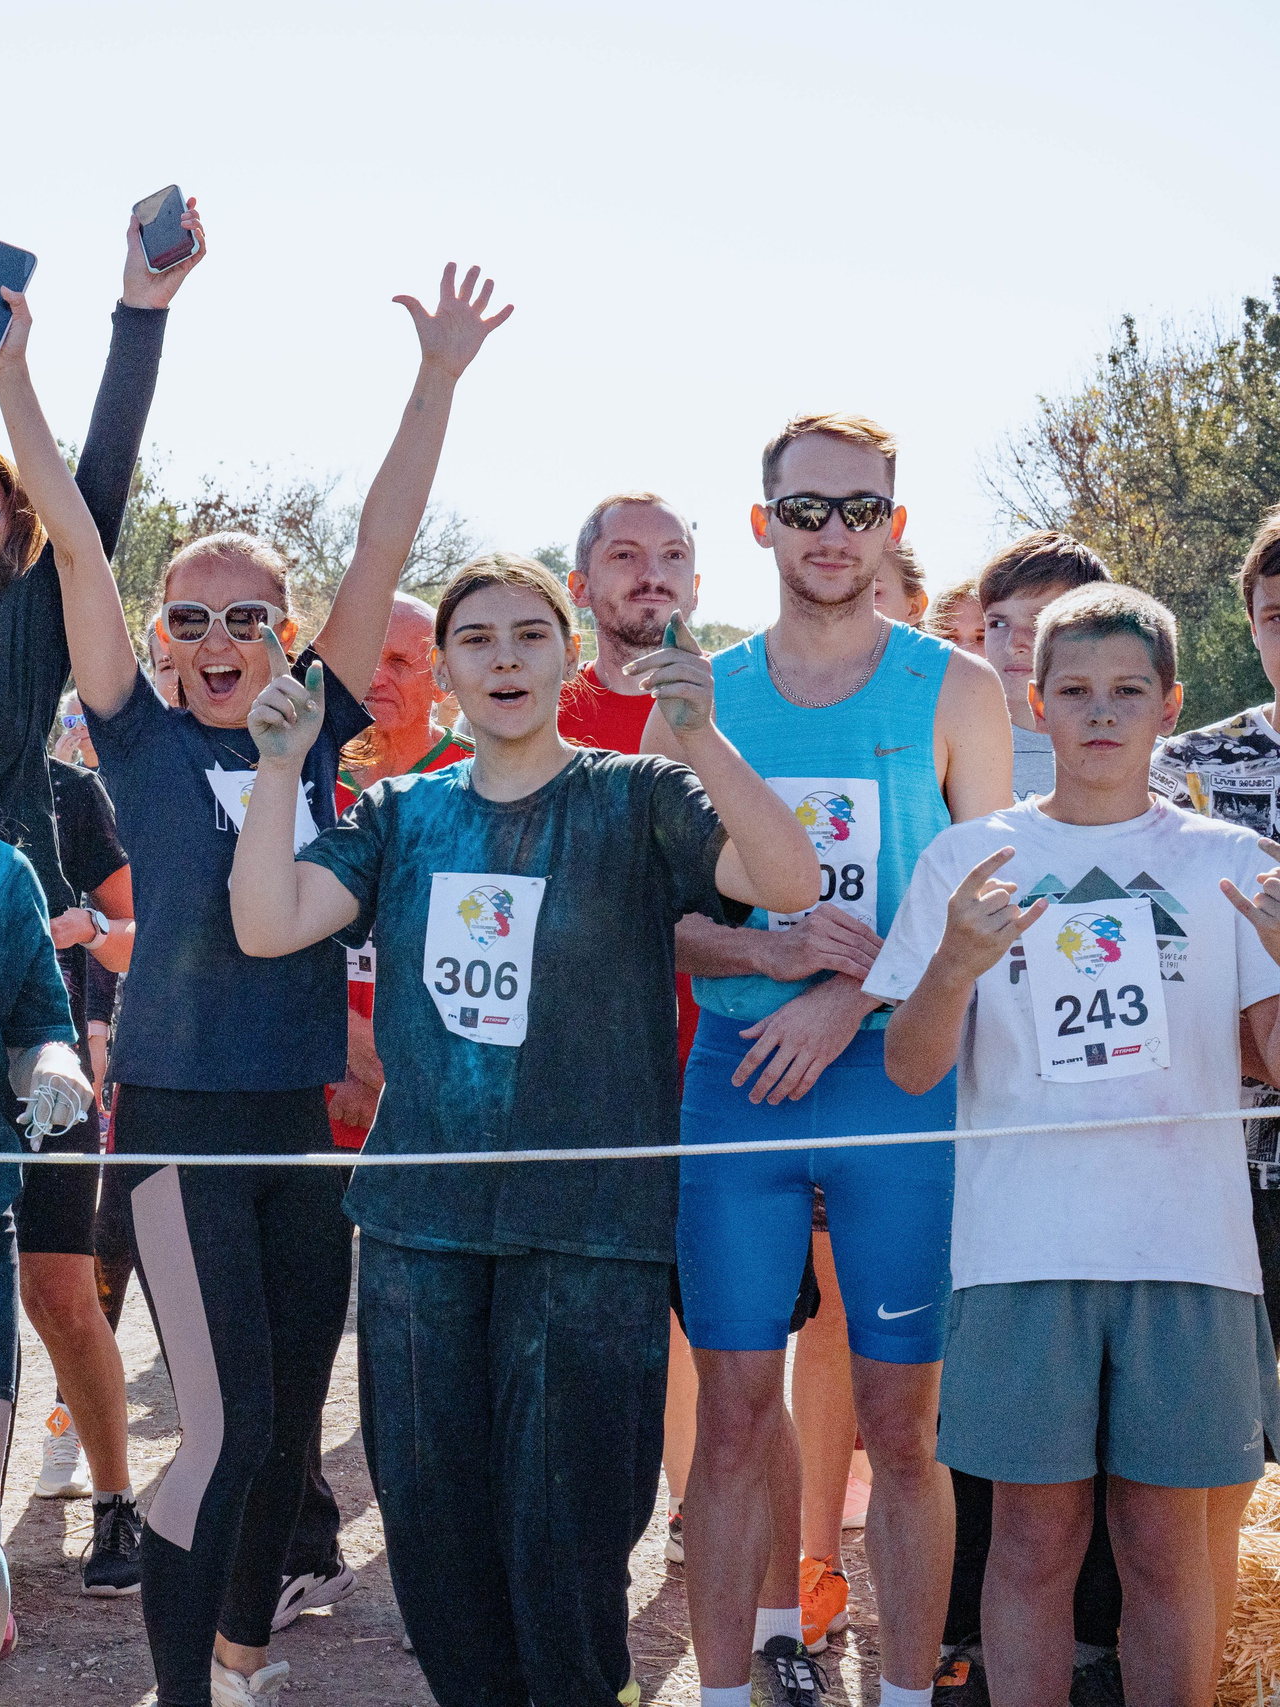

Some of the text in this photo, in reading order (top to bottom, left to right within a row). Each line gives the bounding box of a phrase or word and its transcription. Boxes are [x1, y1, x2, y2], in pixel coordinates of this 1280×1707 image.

[1214, 777, 1272, 787] LIVE MUSIC
[819, 864, 864, 901] 08
[1158, 952, 1188, 961] SWEAR
[434, 956, 518, 1001] 306
[1054, 984, 1149, 1037] 243
